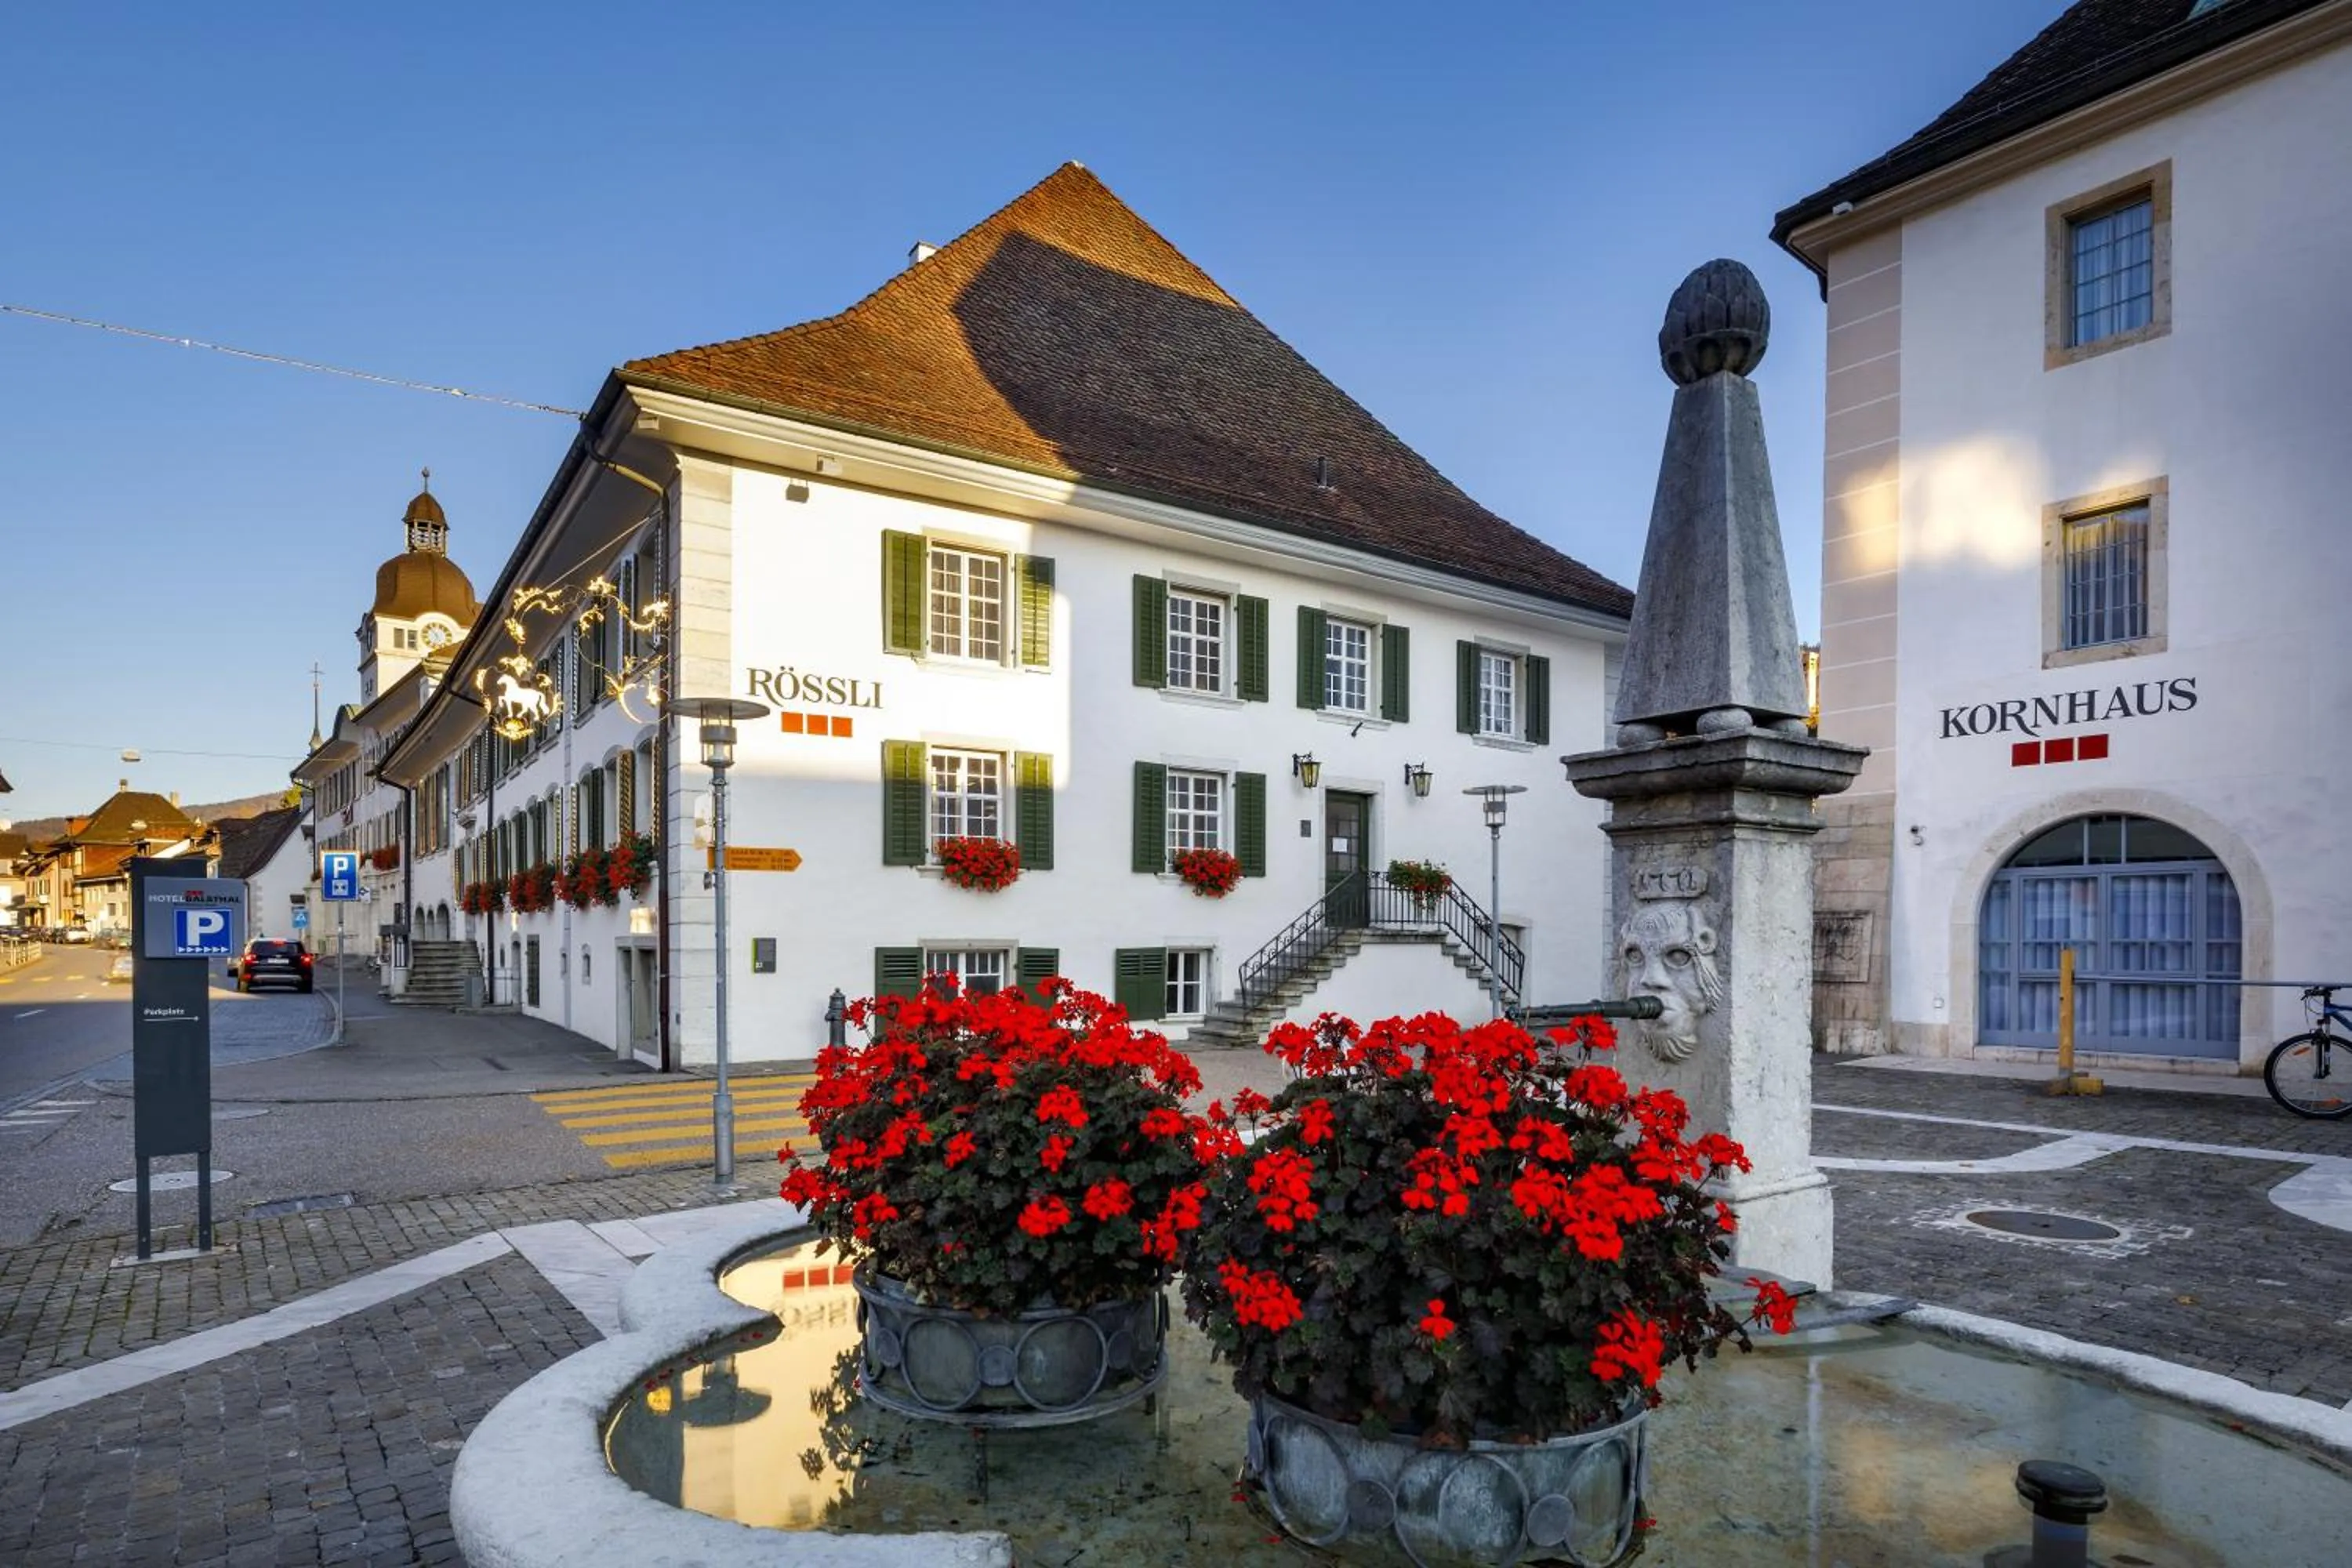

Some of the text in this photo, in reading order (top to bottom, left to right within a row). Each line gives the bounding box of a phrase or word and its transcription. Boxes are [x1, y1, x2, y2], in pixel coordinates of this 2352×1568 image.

[746, 666, 883, 709] RÖSSLI
[1940, 677, 2198, 739] KORNHAUS
[334, 857, 349, 879] P
[187, 911, 225, 946] P
